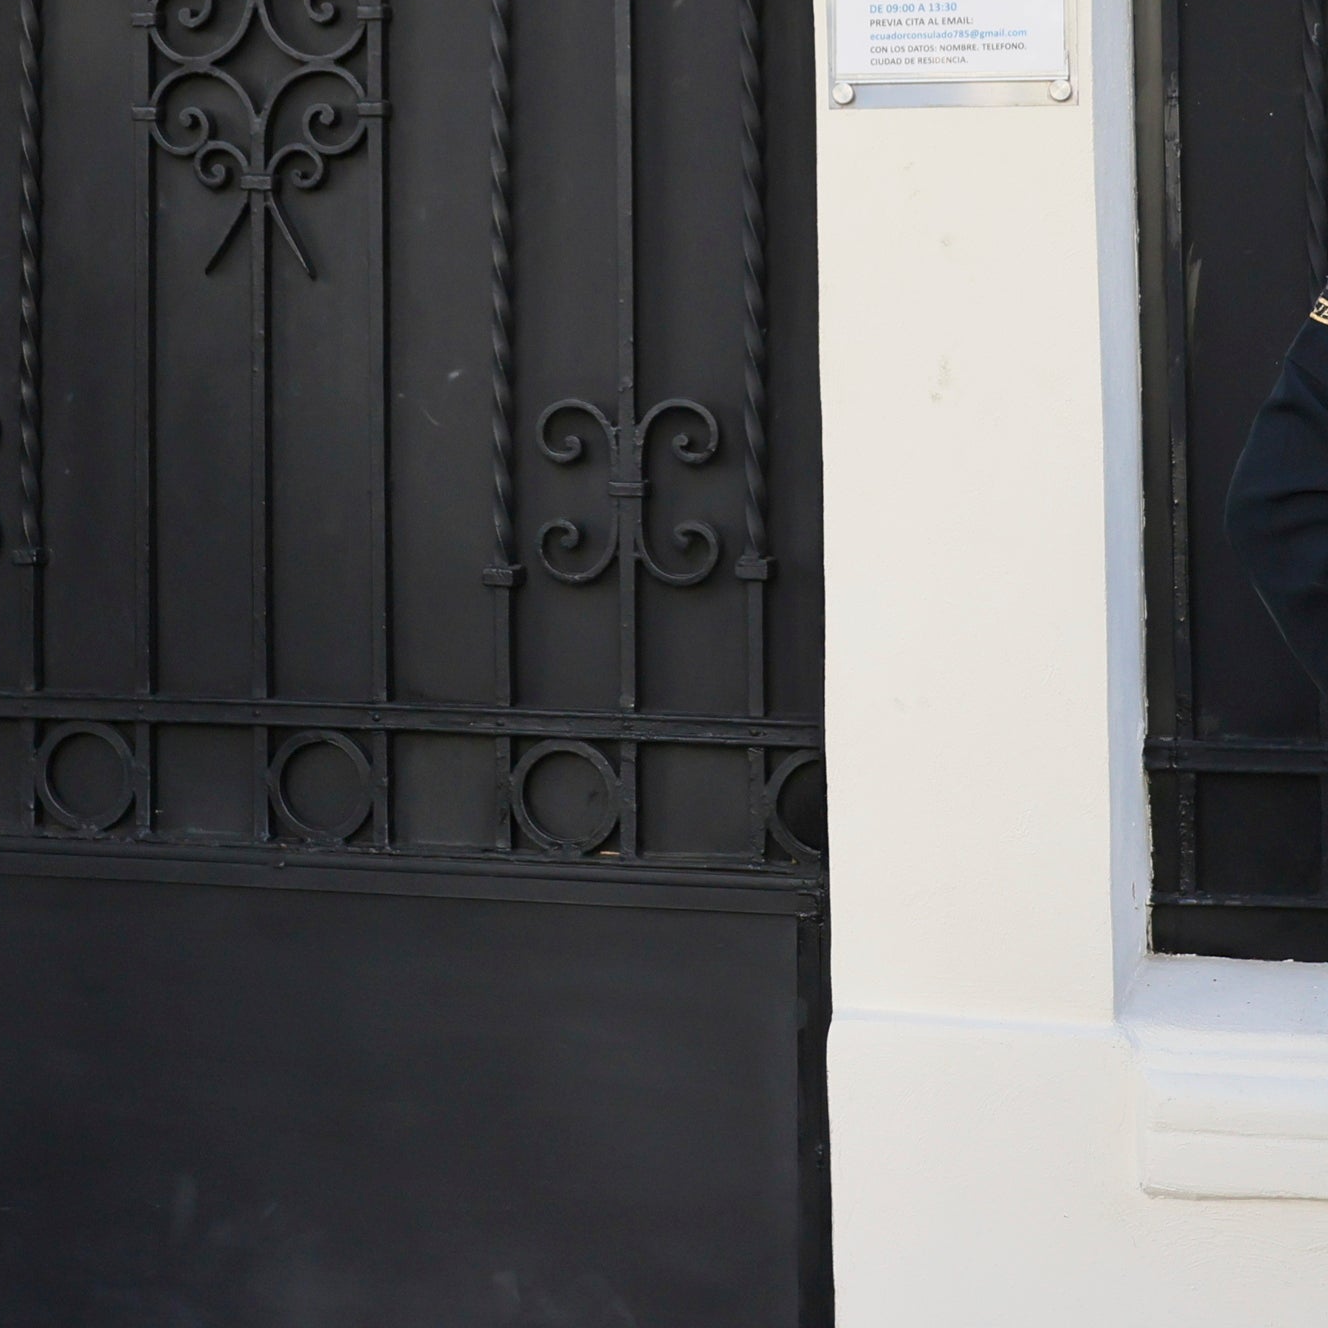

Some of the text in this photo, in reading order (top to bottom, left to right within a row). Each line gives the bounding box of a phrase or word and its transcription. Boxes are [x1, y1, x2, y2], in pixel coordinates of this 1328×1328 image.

[869, 1, 958, 14] DE 09:00 A 13:30
[869, 16, 974, 28] PREVIA CITA AL EMAIL:
[870, 45, 888, 54] CON
[890, 45, 906, 54] LOS
[870, 57, 903, 66] CIUDAD
[904, 56, 915, 65] DE
